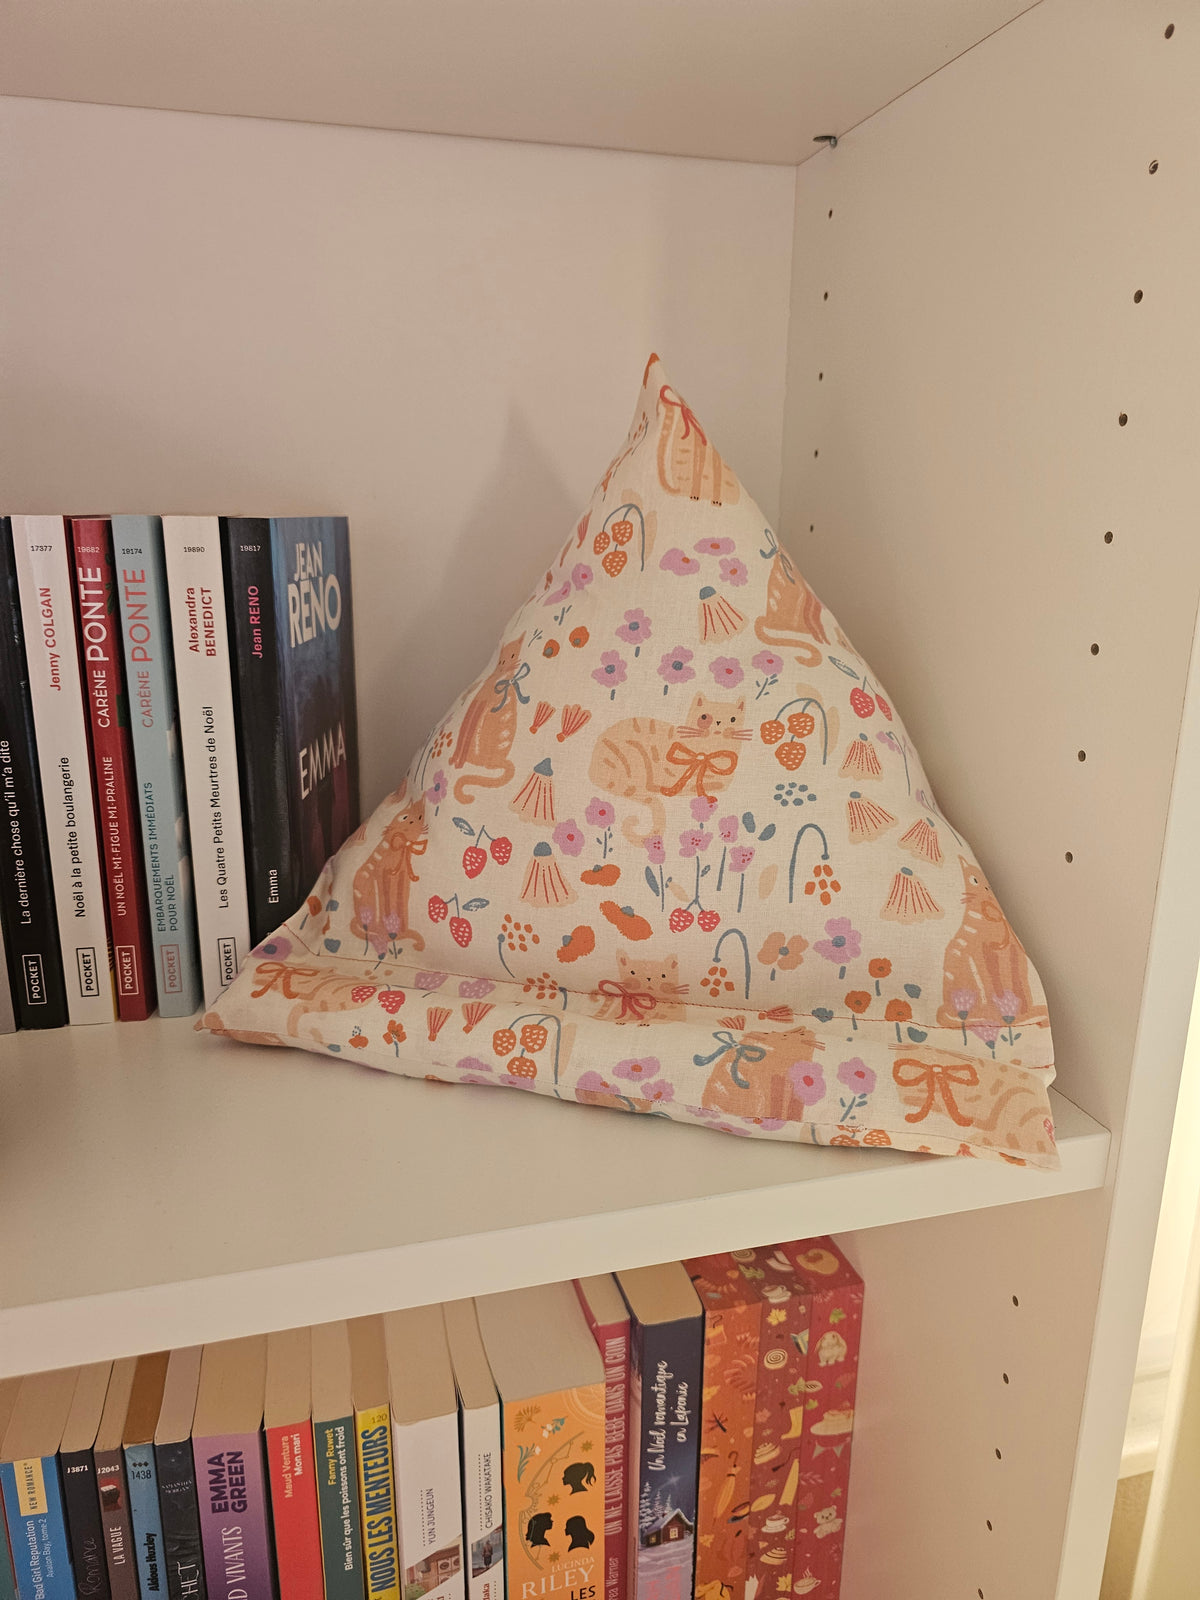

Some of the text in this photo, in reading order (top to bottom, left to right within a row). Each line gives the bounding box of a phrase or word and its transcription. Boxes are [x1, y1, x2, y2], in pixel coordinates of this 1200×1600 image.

[294, 542, 324, 581] JEAN
[39, 587, 62, 692] Jenny COLGAN
[185, 587, 200, 653] Alexandra
[200, 587, 216, 656] BENEDICT
[248, 586, 264, 659] Jean RENO
[288, 574, 342, 648] RENO
[78, 567, 111, 728] CARÈNE PONTE
[123, 569, 154, 728] CARÈNE PONTE
[299, 721, 347, 800] EMMA
[58, 757, 76, 828] boulangerie
[202, 706, 229, 909] Les Quatre Petits Meurtres de Noël
[0, 740, 32, 924] La dernière chose qu'il m'a dite
[67, 831, 82, 864] petite
[102, 756, 127, 916] UN NOËL MI-FIGUE MI-PRALINE
[144, 782, 166, 932] EMBARQUEMENTS IMMÉDIATS
[71, 868, 82, 878] la
[268, 869, 280, 904] Emma
[73, 892, 86, 918] Noël
[166, 874, 180, 932] POUR NOËL
[28, 960, 42, 999] POCKET
[82, 953, 95, 991] POCKET
[122, 951, 134, 990] POCKET
[164, 950, 178, 989] POCKET
[223, 943, 234, 980] POCKET
[605, 1336, 626, 1363] COIN
[606, 1364, 626, 1383] UN
[605, 1384, 626, 1414] DANS
[647, 1360, 674, 1471] Un Noël romantique
[670, 1381, 692, 1442] en Laponie
[132, 1470, 152, 1480] 1438
[207, 1452, 229, 1514] EMMA
[227, 1451, 248, 1514] GREEN
[281, 1436, 294, 1498] Maud Ventura
[290, 1433, 304, 1476] Mon mari
[326, 1428, 338, 1486] Fanny Ruwet
[605, 1444, 624, 1466] PAS
[28, 1496, 38, 1510] NEW
[334, 1426, 353, 1571] Bien sûr que les poissons ont froid
[361, 1425, 396, 1594] NOUS LES MENTEURS
[483, 1452, 494, 1529] CHISAKO WAKATAKE
[604, 1466, 623, 1503] LAISSE
[604, 1504, 622, 1520] NE
[426, 1488, 437, 1545] YUN JUNGEUN
[26, 1520, 45, 1600] Bad Girl Reputation
[46, 1556, 54, 1578] Avalon
[110, 1526, 126, 1566] LA VAGUE
[144, 1532, 160, 1592] Aldous Huxley
[222, 1526, 248, 1584] VIVANTS
[552, 1556, 595, 1573] LUCINDA
[522, 1565, 594, 1600] RILEY
[571, 1586, 596, 1600] LES
